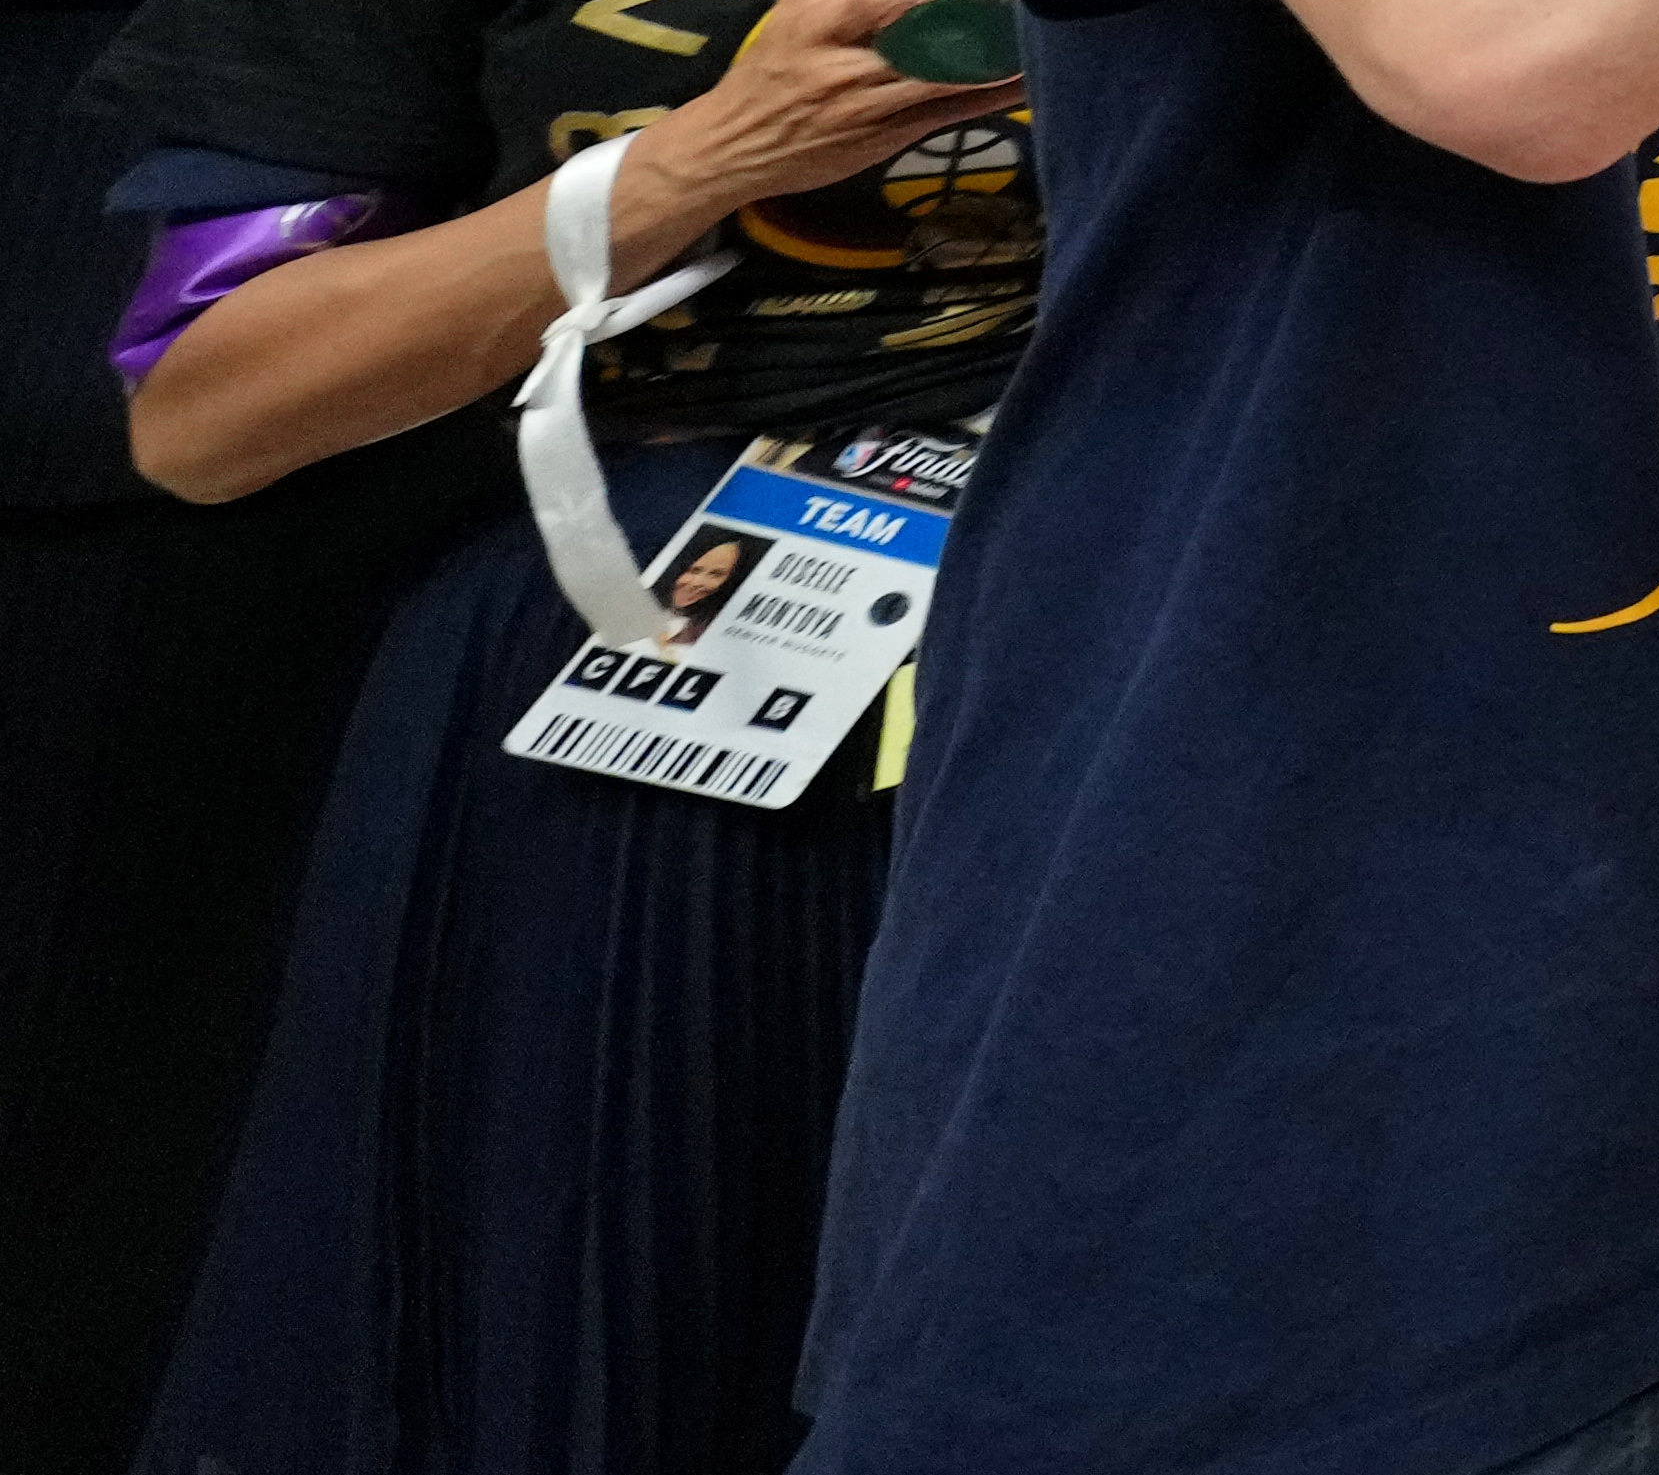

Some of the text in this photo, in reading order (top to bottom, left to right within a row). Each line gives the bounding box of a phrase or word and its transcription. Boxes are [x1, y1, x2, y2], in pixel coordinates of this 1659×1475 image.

[797, 495, 909, 546] TEAM
[735, 591, 846, 641] MONTOYA
[581, 654, 704, 701] C F L
